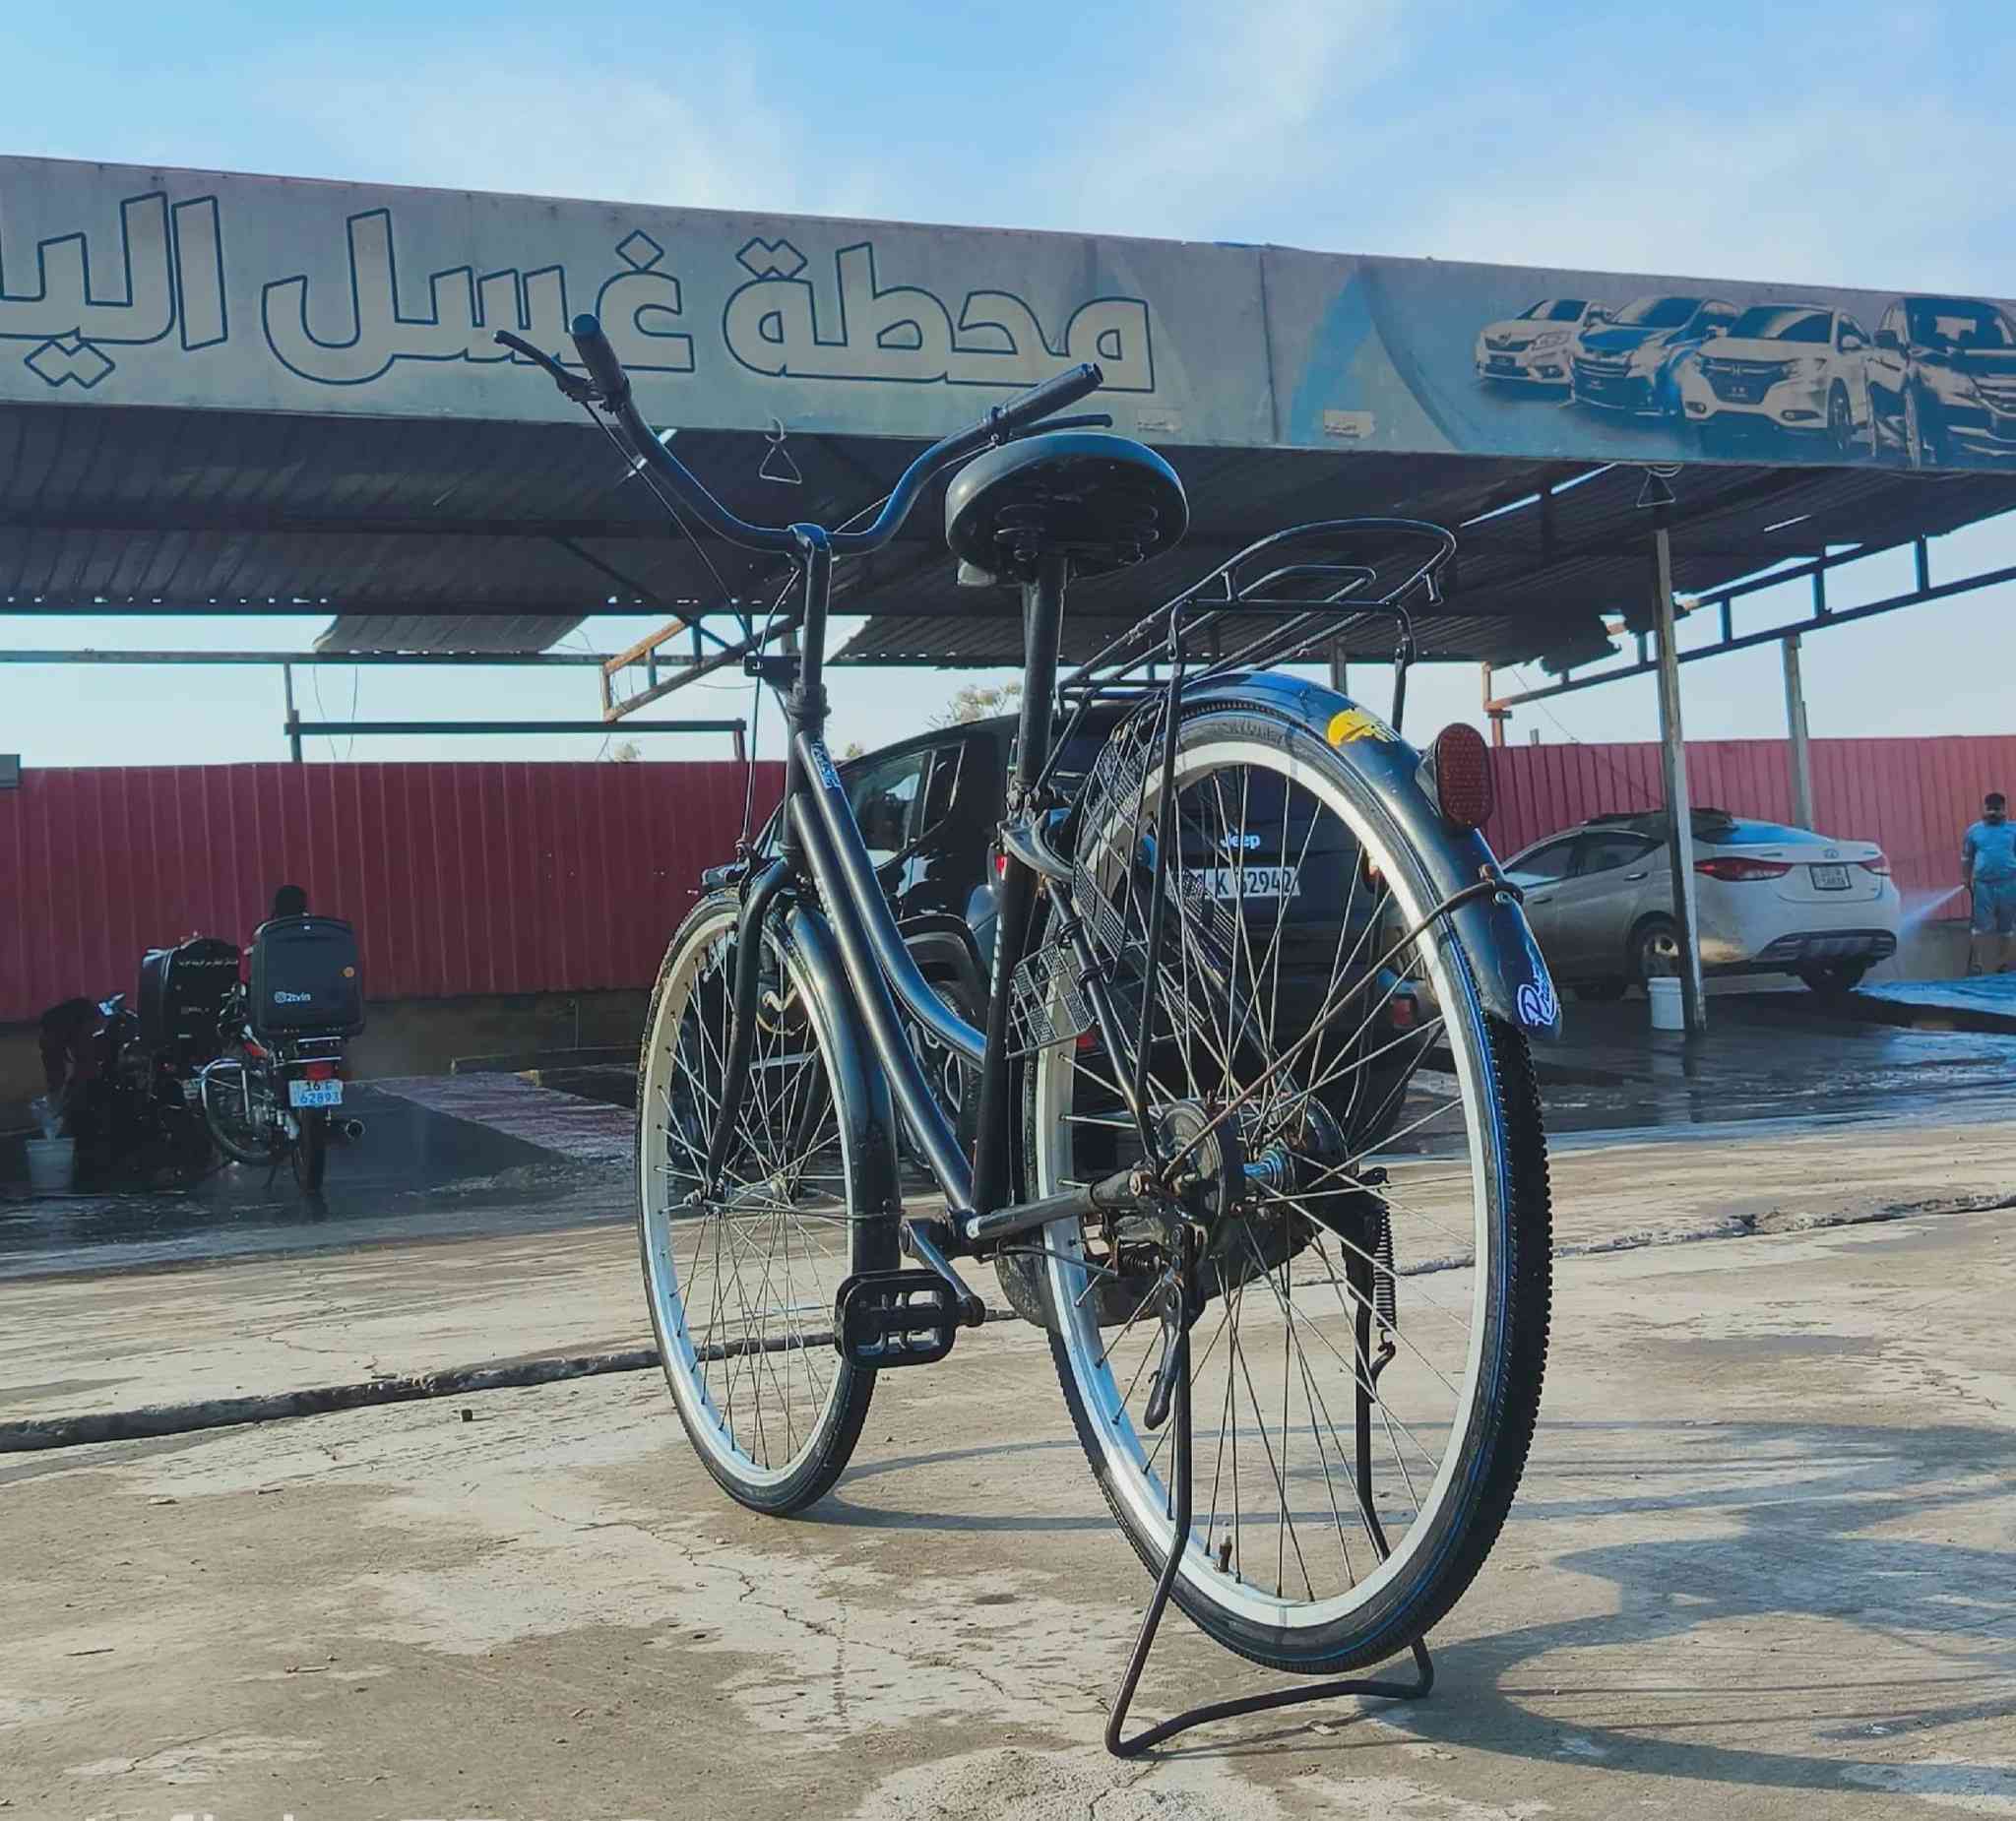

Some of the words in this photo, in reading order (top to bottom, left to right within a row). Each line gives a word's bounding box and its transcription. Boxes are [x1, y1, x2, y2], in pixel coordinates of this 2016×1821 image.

[0, 190, 228, 389] الي
[261, 208, 695, 385] غسل
[723, 236, 1155, 392] محطة
[1220, 832, 1261, 849] Jeep
